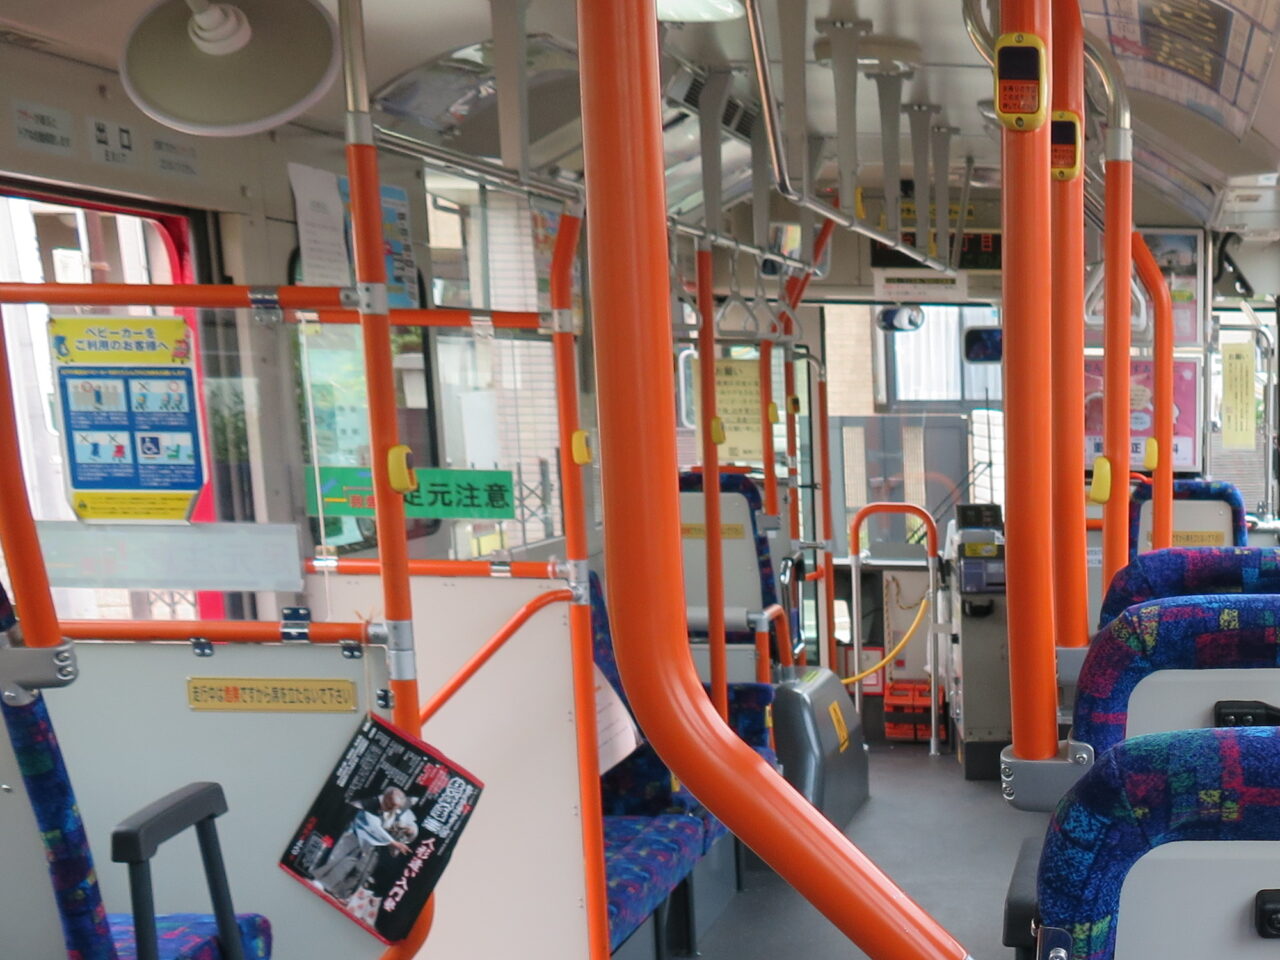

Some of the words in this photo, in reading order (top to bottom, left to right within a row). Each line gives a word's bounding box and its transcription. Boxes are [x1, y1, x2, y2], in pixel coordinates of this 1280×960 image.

[85, 327, 156, 339] ベビーカーを
[75, 339, 169, 352] ご利用のお客様へ
